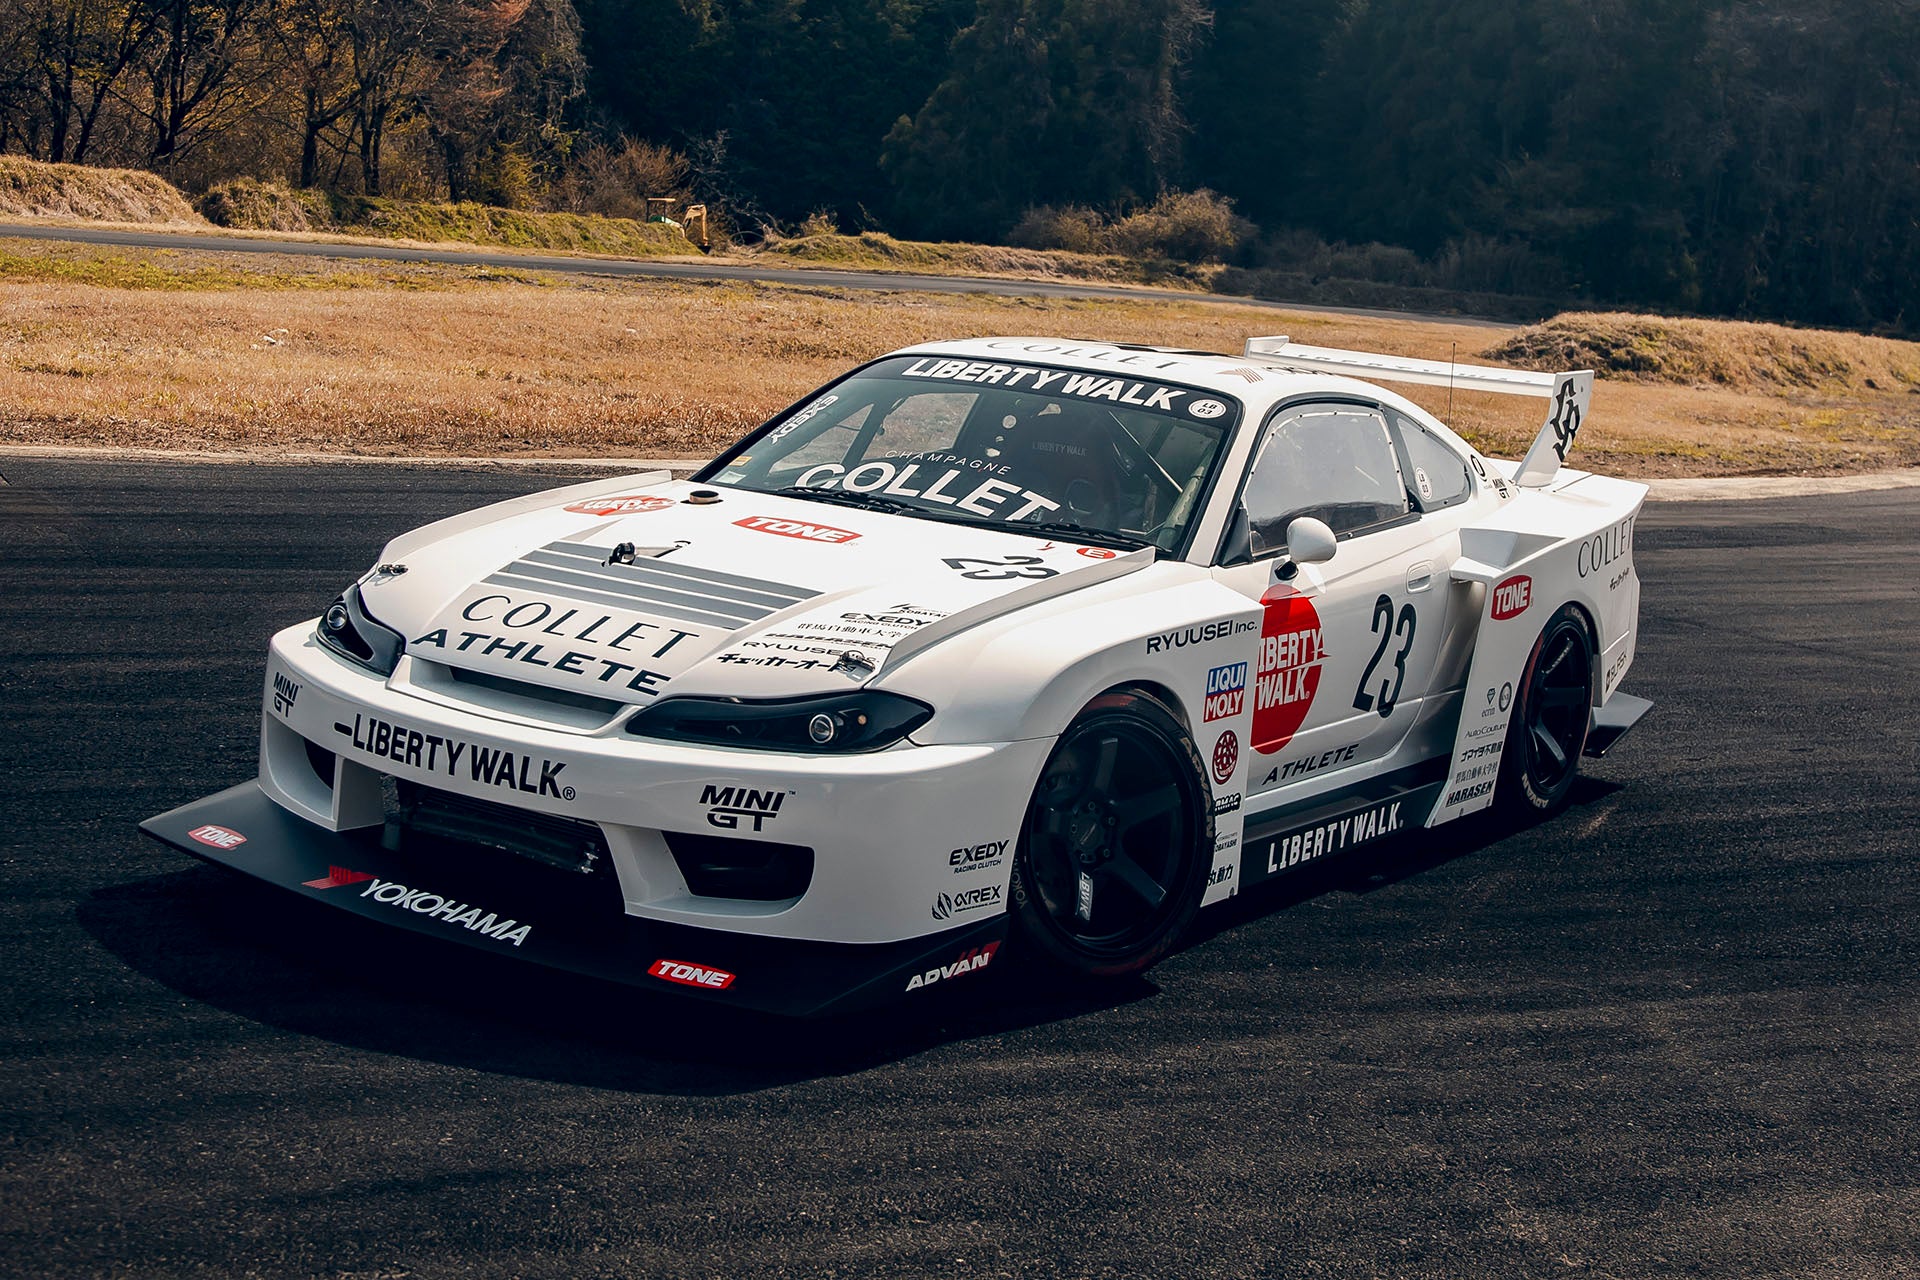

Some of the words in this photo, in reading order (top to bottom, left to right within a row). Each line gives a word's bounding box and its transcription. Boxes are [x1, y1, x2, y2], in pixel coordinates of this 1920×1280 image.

[987, 342, 1188, 369] COLLET
[902, 358, 1067, 391] LIBERTY
[1061, 374, 1187, 411] WALK
[1197, 408, 1213, 416] 03
[1202, 402, 1218, 411] LB
[884, 450, 1013, 477] CHAMPAGNE
[795, 462, 1061, 520] COLLET
[747, 518, 853, 542] TONE
[1578, 515, 1634, 578] COLLET
[941, 556, 1061, 579] 23
[1495, 580, 1530, 615] TONE
[462, 595, 700, 659] COLLET
[840, 612, 932, 627] EXEDY
[1146, 620, 1233, 654] RYUUSEI
[1235, 619, 1258, 634] Inc.
[410, 629, 673, 696] ATHLETE
[1352, 594, 1417, 719] 23
[1207, 664, 1246, 694] LIQUI
[274, 691, 295, 718] GT
[1204, 691, 1244, 721] MOLY
[1261, 744, 1360, 785] ATHLETE
[1446, 780, 1495, 806] HARASEN
[707, 806, 778, 832] GT
[194, 825, 245, 849] TONE
[1267, 817, 1353, 873] LIBERTY
[949, 840, 1010, 866] EXEDY
[954, 863, 977, 874] RACING
[978, 858, 1002, 869] CLUTCH
[360, 879, 533, 947] YOKOHAMA
[657, 960, 731, 987] TONE
[906, 951, 990, 992] ADVAN
